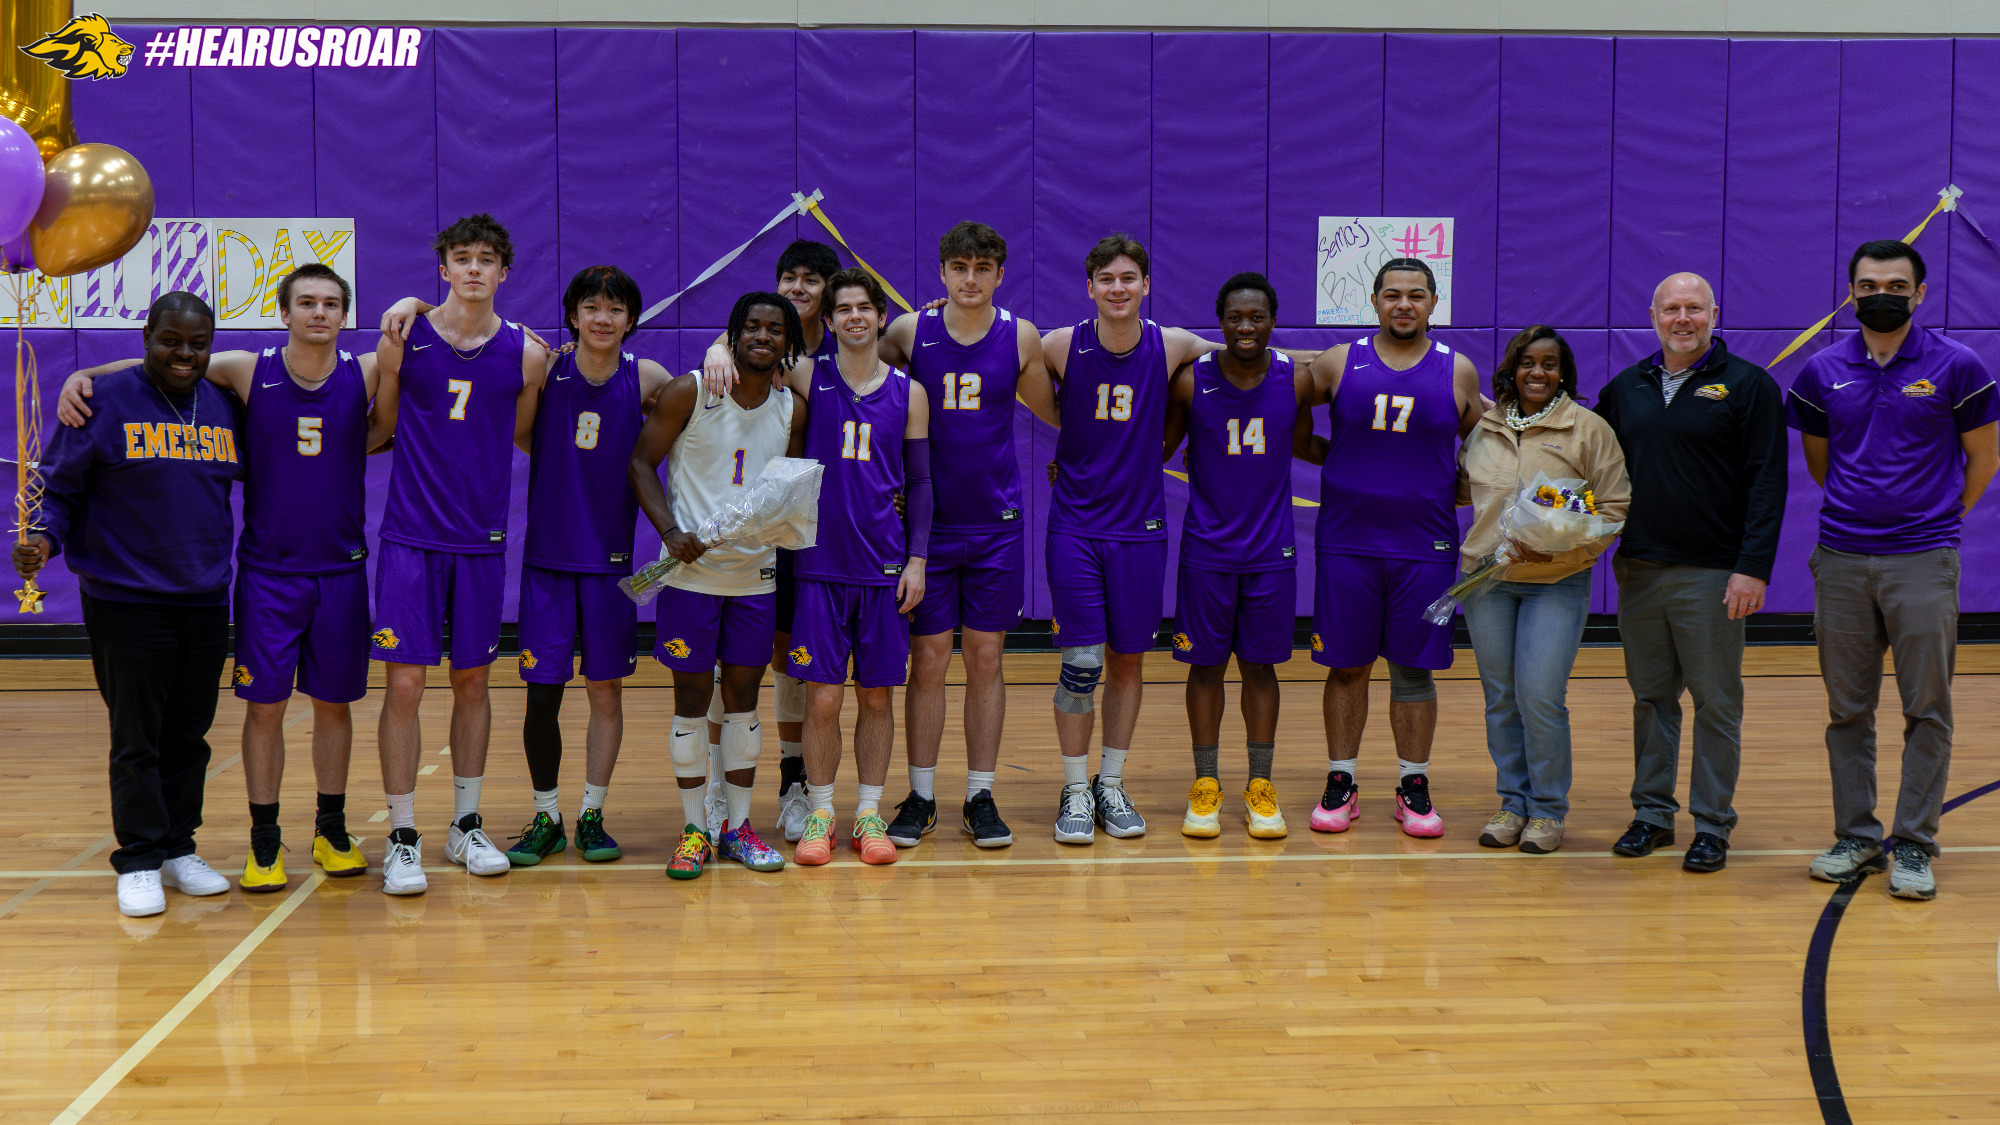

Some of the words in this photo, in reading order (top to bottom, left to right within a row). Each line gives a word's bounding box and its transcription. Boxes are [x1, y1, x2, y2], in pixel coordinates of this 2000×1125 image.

[1392, 223, 1452, 259] #1
[217, 229, 353, 320] DAY
[1318, 307, 1349, 316] PARENTS
[448, 379, 472, 420] 7
[943, 372, 981, 410] 12
[1095, 383, 1133, 421] 13
[575, 411, 601, 450] 8
[1372, 394, 1414, 432] 17
[123, 422, 238, 463] EMERSON
[297, 416, 323, 456] 5
[842, 420, 871, 461] 11
[1227, 418, 1266, 455] 14
[731, 448, 746, 487] 1
